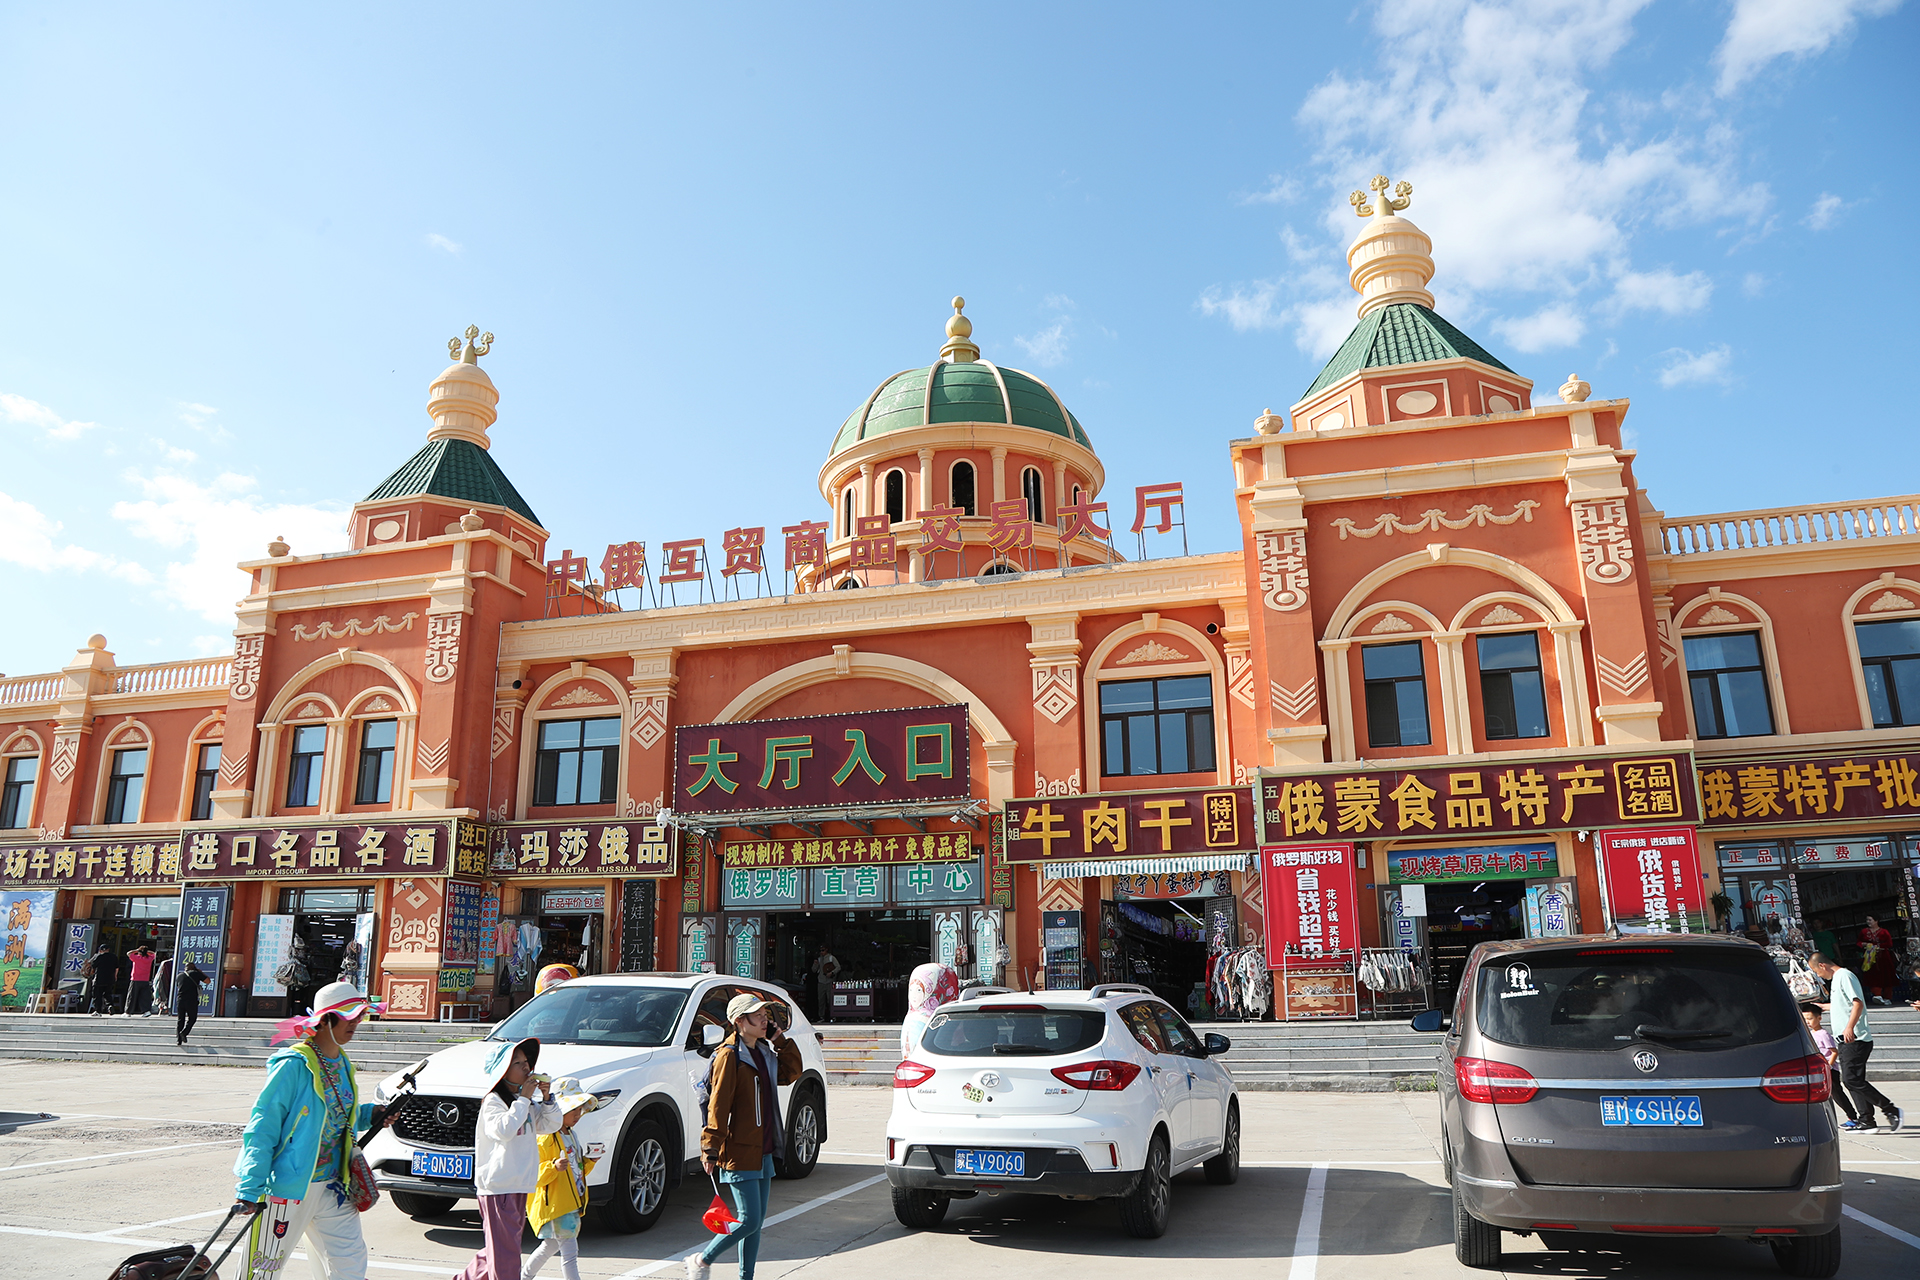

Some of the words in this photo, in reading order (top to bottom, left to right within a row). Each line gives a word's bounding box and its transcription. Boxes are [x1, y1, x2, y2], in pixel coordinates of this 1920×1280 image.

[546, 481, 1184, 597] 中俄互贸商品交易大厅
[685, 722, 953, 797] 大厅入口
[1624, 765, 1671, 790] 名品
[1697, 758, 1920, 819] 俄蒙特产批
[1264, 785, 1281, 824] 五姐
[1277, 764, 1606, 837] 俄蒙食品特产
[1627, 790, 1674, 814] 名酒
[460, 824, 487, 847] 进口
[1007, 810, 1020, 841] 五姐
[1020, 799, 1192, 856] 牛肉干
[1210, 798, 1232, 842] 特产
[0, 843, 179, 880] 场牛肉干连锁超
[188, 827, 437, 870] 进口名品名酒
[519, 826, 668, 866] 玛莎俄品
[726, 842, 786, 866] 现场制作
[904, 834, 969, 860] 免费品尝
[1272, 850, 1343, 867] 俄罗斯好物
[1728, 849, 1773, 864] 正品
[551, 866, 590, 874] MARTHA
[1399, 850, 1551, 877] 现烤草原牛肉干
[730, 867, 798, 900] 俄罗斯
[822, 866, 879, 897] 直营
[907, 863, 973, 895] 中心
[190, 896, 219, 912] 洋酒
[1296, 868, 1323, 960] 省钱超市
[1325, 889, 1339, 922] 花少钱
[1545, 894, 1564, 931] 香肠
[439, 970, 475, 989] 低价包邮
[1604, 1100, 1699, 1121] 黑M·6SH66
[413, 1154, 469, 1176] 蒙E·QN381
[957, 1153, 1023, 1172] 蒙E·V9060
